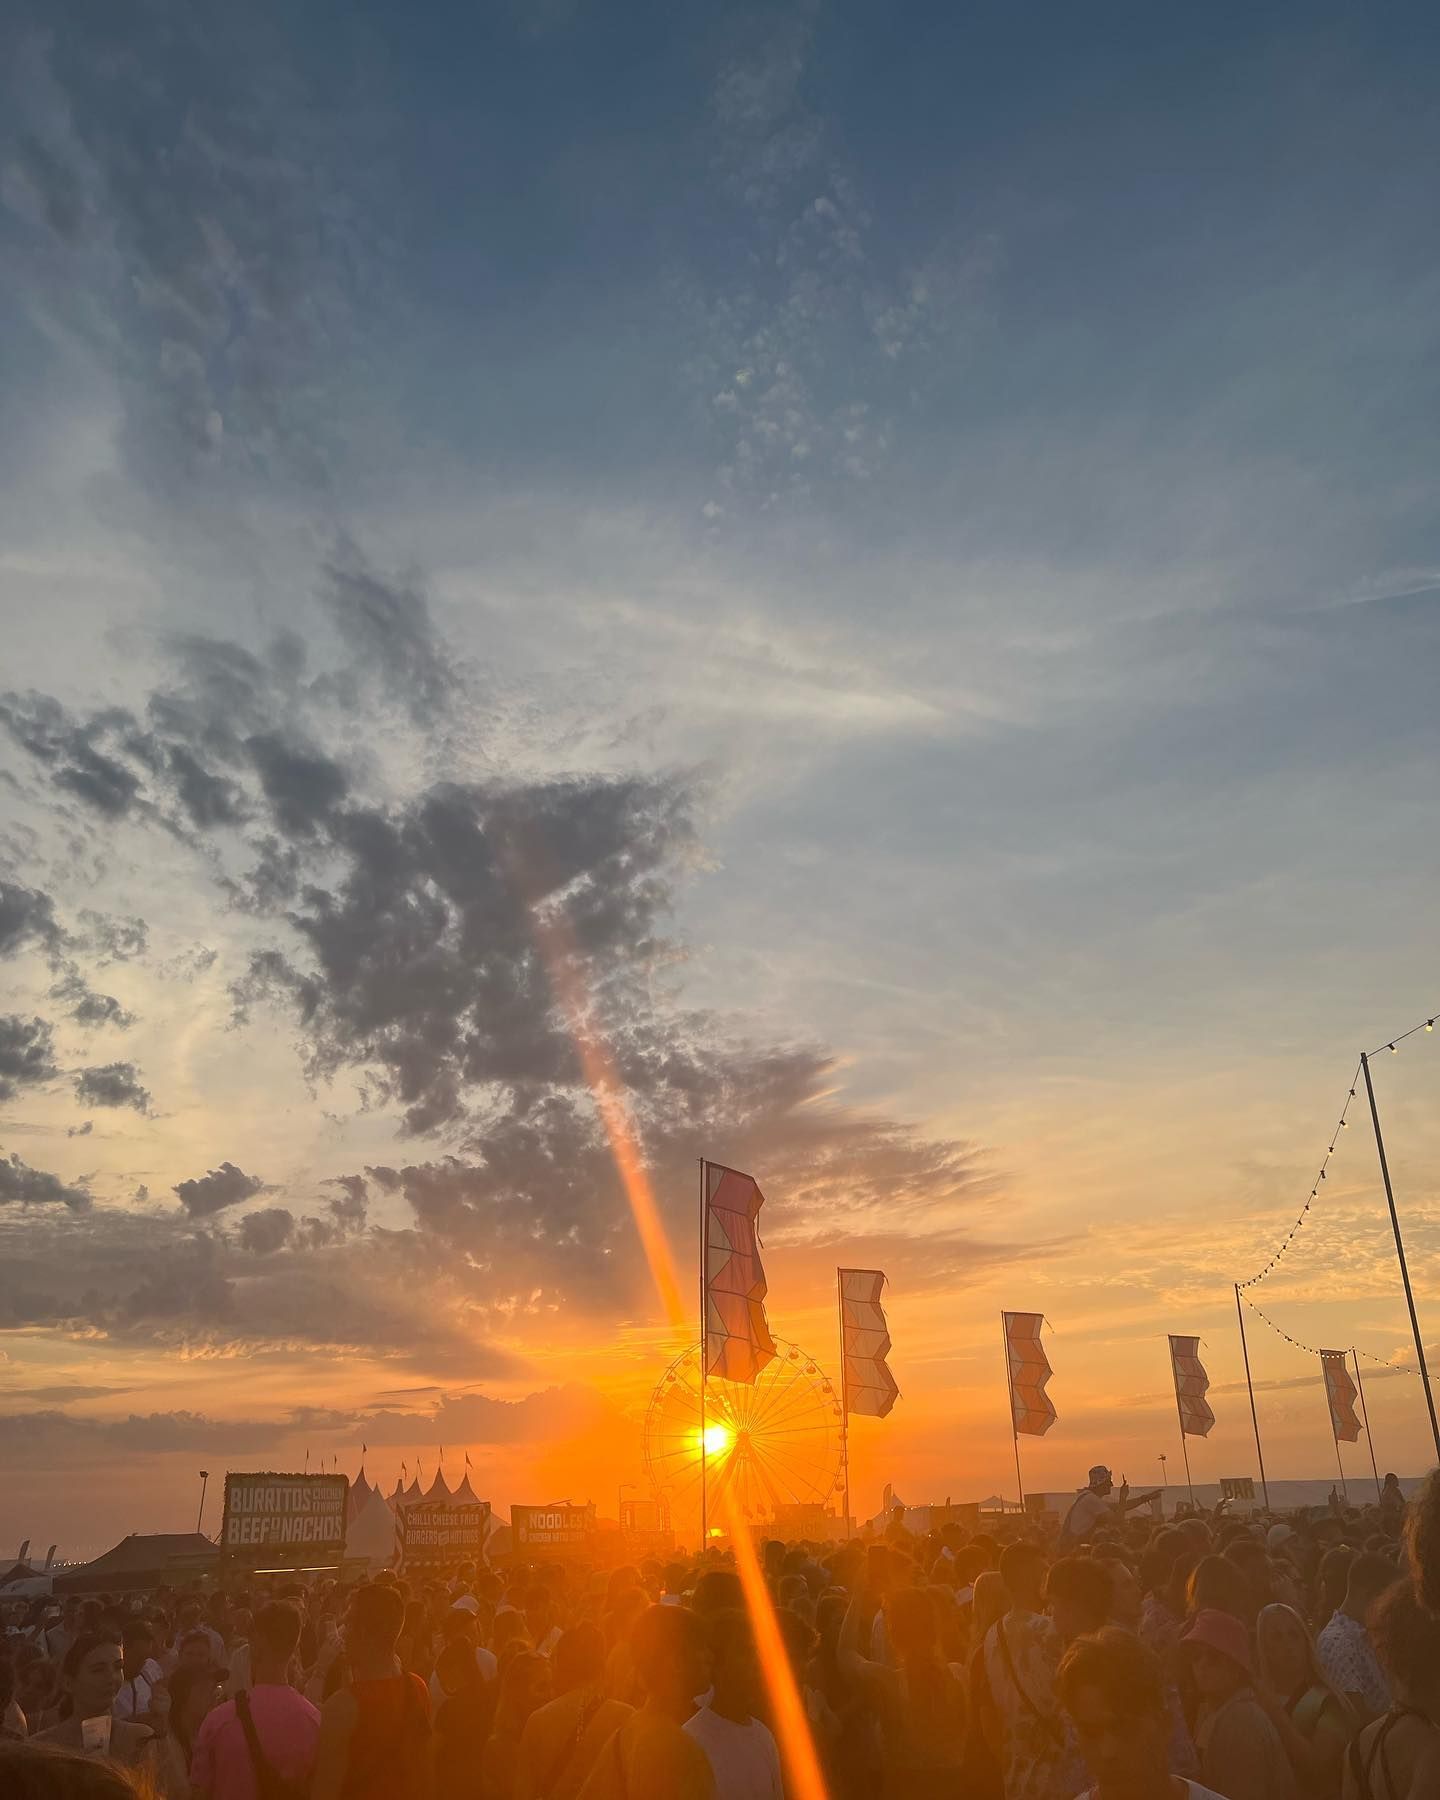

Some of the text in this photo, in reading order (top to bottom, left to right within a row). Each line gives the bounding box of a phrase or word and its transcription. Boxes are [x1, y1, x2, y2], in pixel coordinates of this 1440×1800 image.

[1224, 1482, 1255, 1499] BAR
[230, 1487, 312, 1513] BURRITOS
[432, 1512, 459, 1525] CHEESE
[529, 1513, 585, 1529] NOODLES
[227, 1517, 271, 1544] BEEF
[280, 1516, 342, 1541] NACHOS
[406, 1529, 438, 1545] BURGERS
